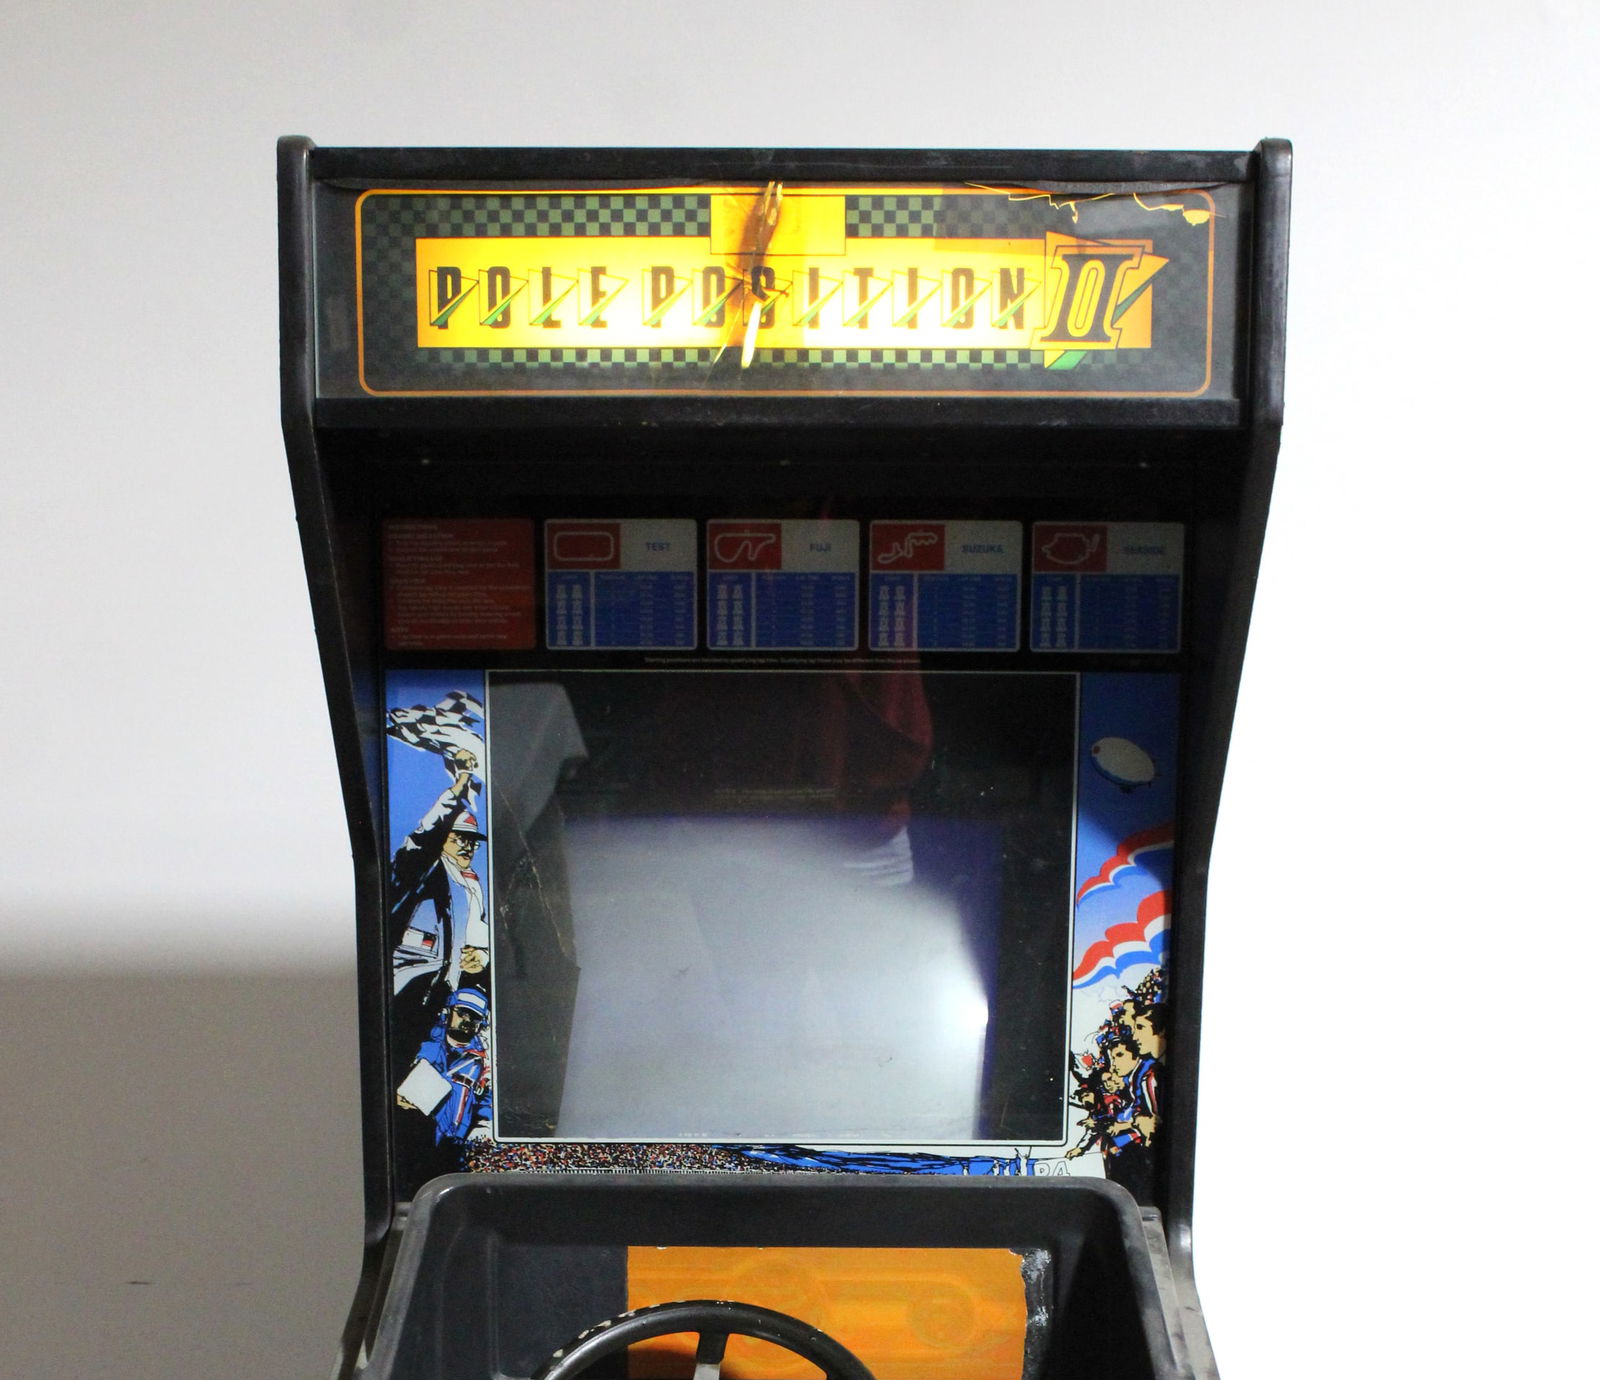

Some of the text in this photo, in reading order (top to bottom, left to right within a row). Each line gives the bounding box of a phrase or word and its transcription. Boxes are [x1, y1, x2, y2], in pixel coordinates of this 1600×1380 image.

[436, 266, 608, 329] POLE
[651, 265, 1025, 329] POSITION
[645, 542, 671, 551] TEST
[809, 543, 832, 553] FUJI
[961, 544, 1004, 554] SUZUKA
